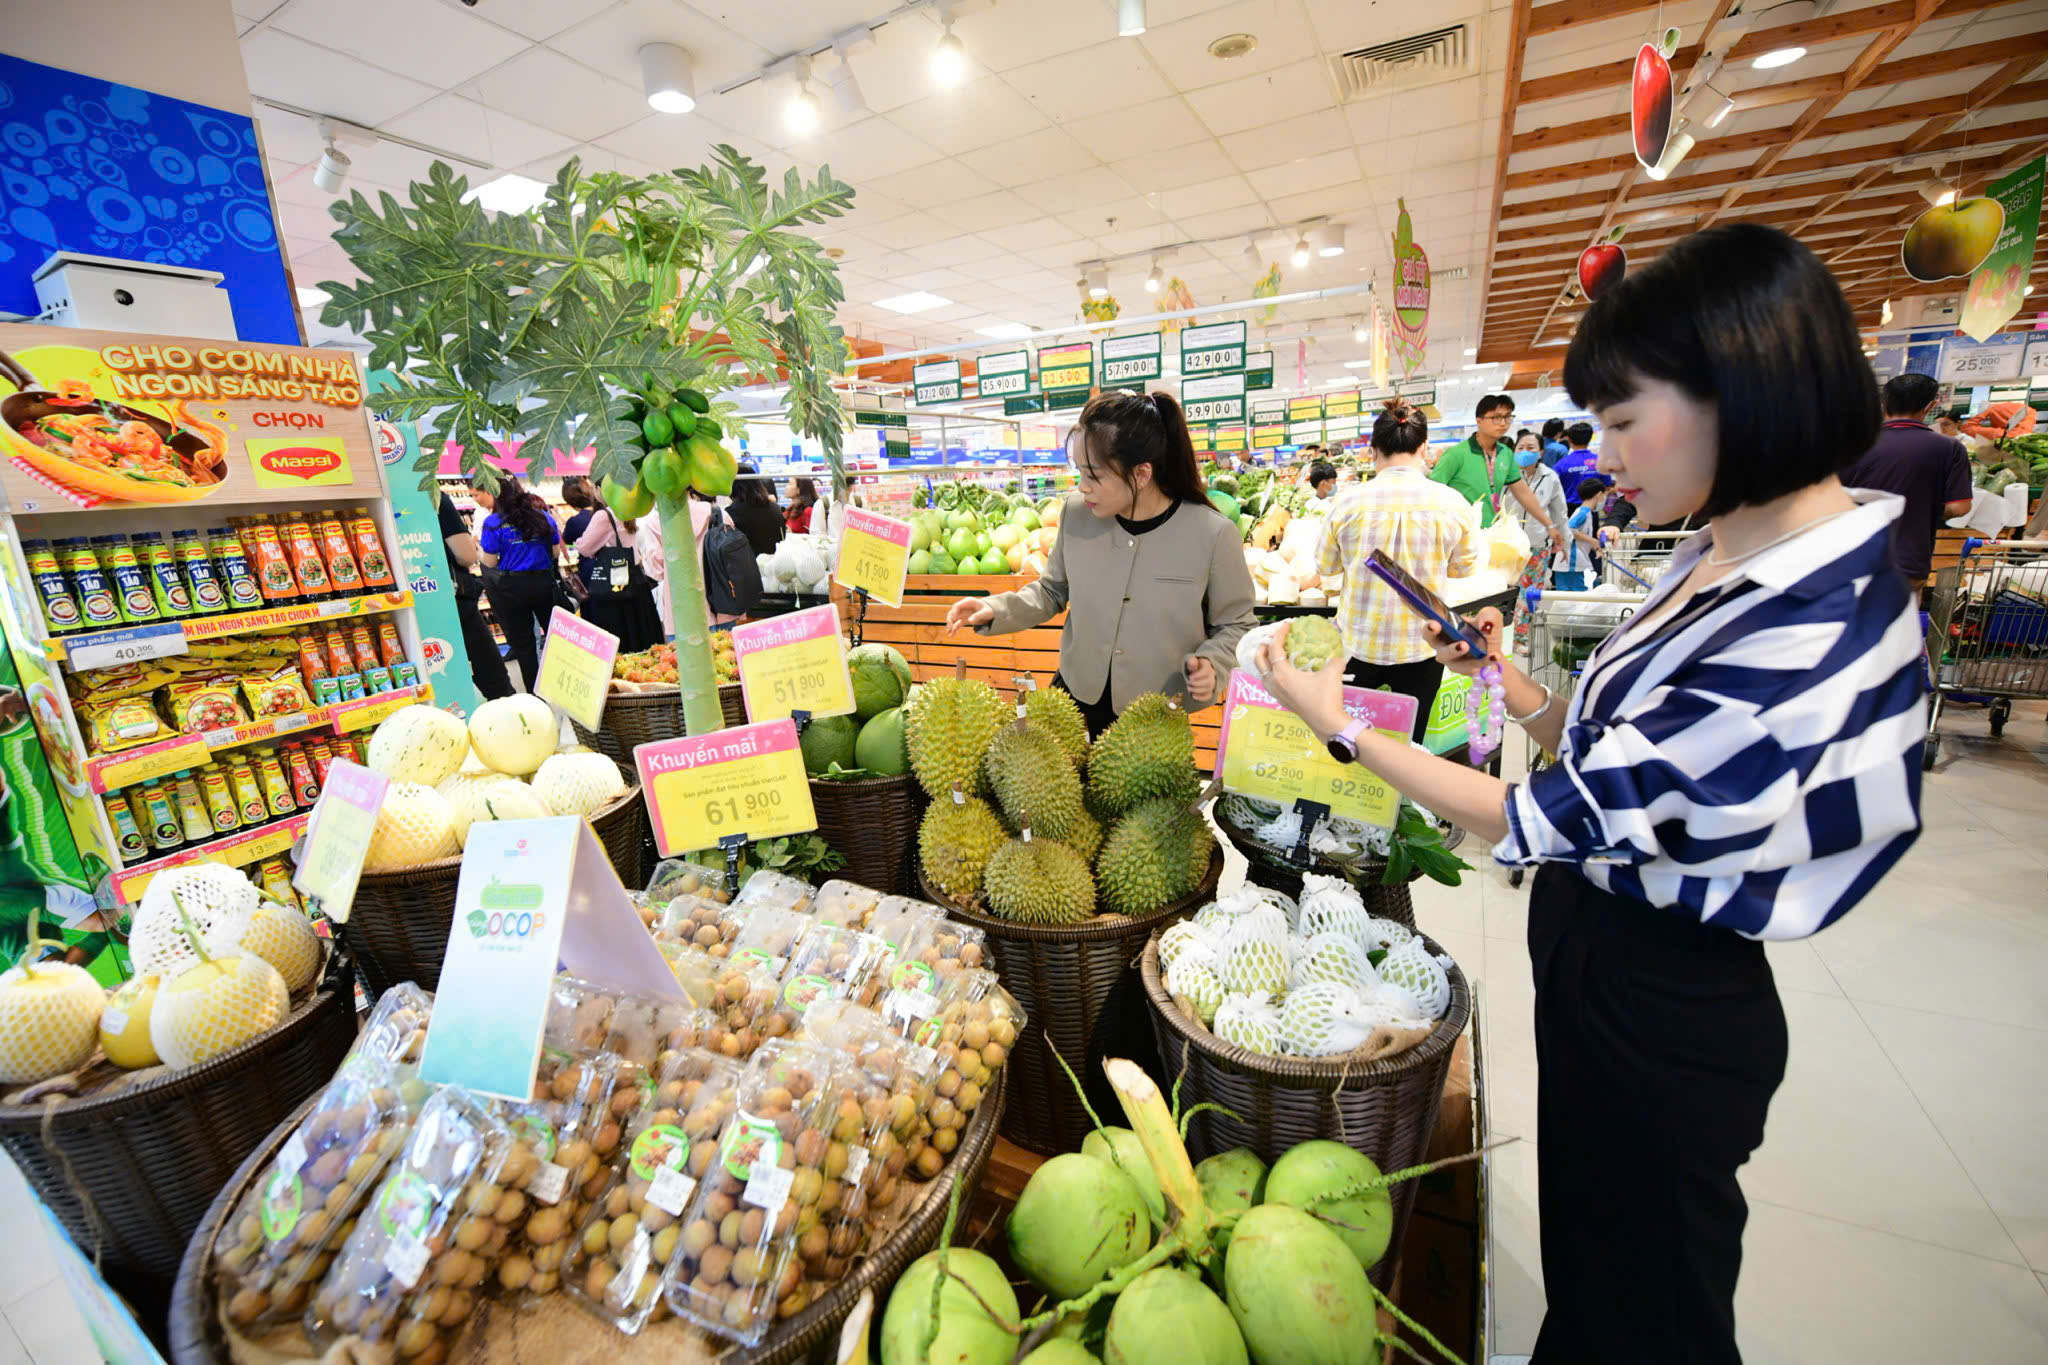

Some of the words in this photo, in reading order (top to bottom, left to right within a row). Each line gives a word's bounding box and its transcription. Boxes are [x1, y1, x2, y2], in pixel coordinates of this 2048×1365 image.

[101, 345, 193, 371] CHO
[199, 347, 286, 375] CƠM
[290, 352, 360, 385] NHÀ
[1107, 361, 1147, 376] 57.900
[1187, 351, 1230, 367] 42.900
[1956, 357, 2000, 372] 25.000
[111, 374, 217, 398] NGON
[218, 374, 303, 398] SÁNG
[305, 382, 360, 407] TẠO
[1188, 403, 1230, 418] 59.900
[253, 412, 325, 430] CHỌN
[270, 454, 333, 469] Maggi
[383, 444, 403, 461] RAND
[855, 559, 889, 581] 41.500
[410, 577, 437, 592] YẾN
[219, 618, 244, 632] NGON
[67, 640, 86, 648] Sản
[88, 634, 115, 645] phẩm
[116, 631, 134, 640] mới
[738, 629, 780, 652] Khuyến
[774, 672, 825, 703] 51.900
[648, 739, 719, 771] Khuyến
[1255, 761, 1304, 782] 62.900
[1330, 777, 1385, 800] 92.500
[705, 790, 781, 825] 61.900
[488, 911, 545, 937] OCOP
